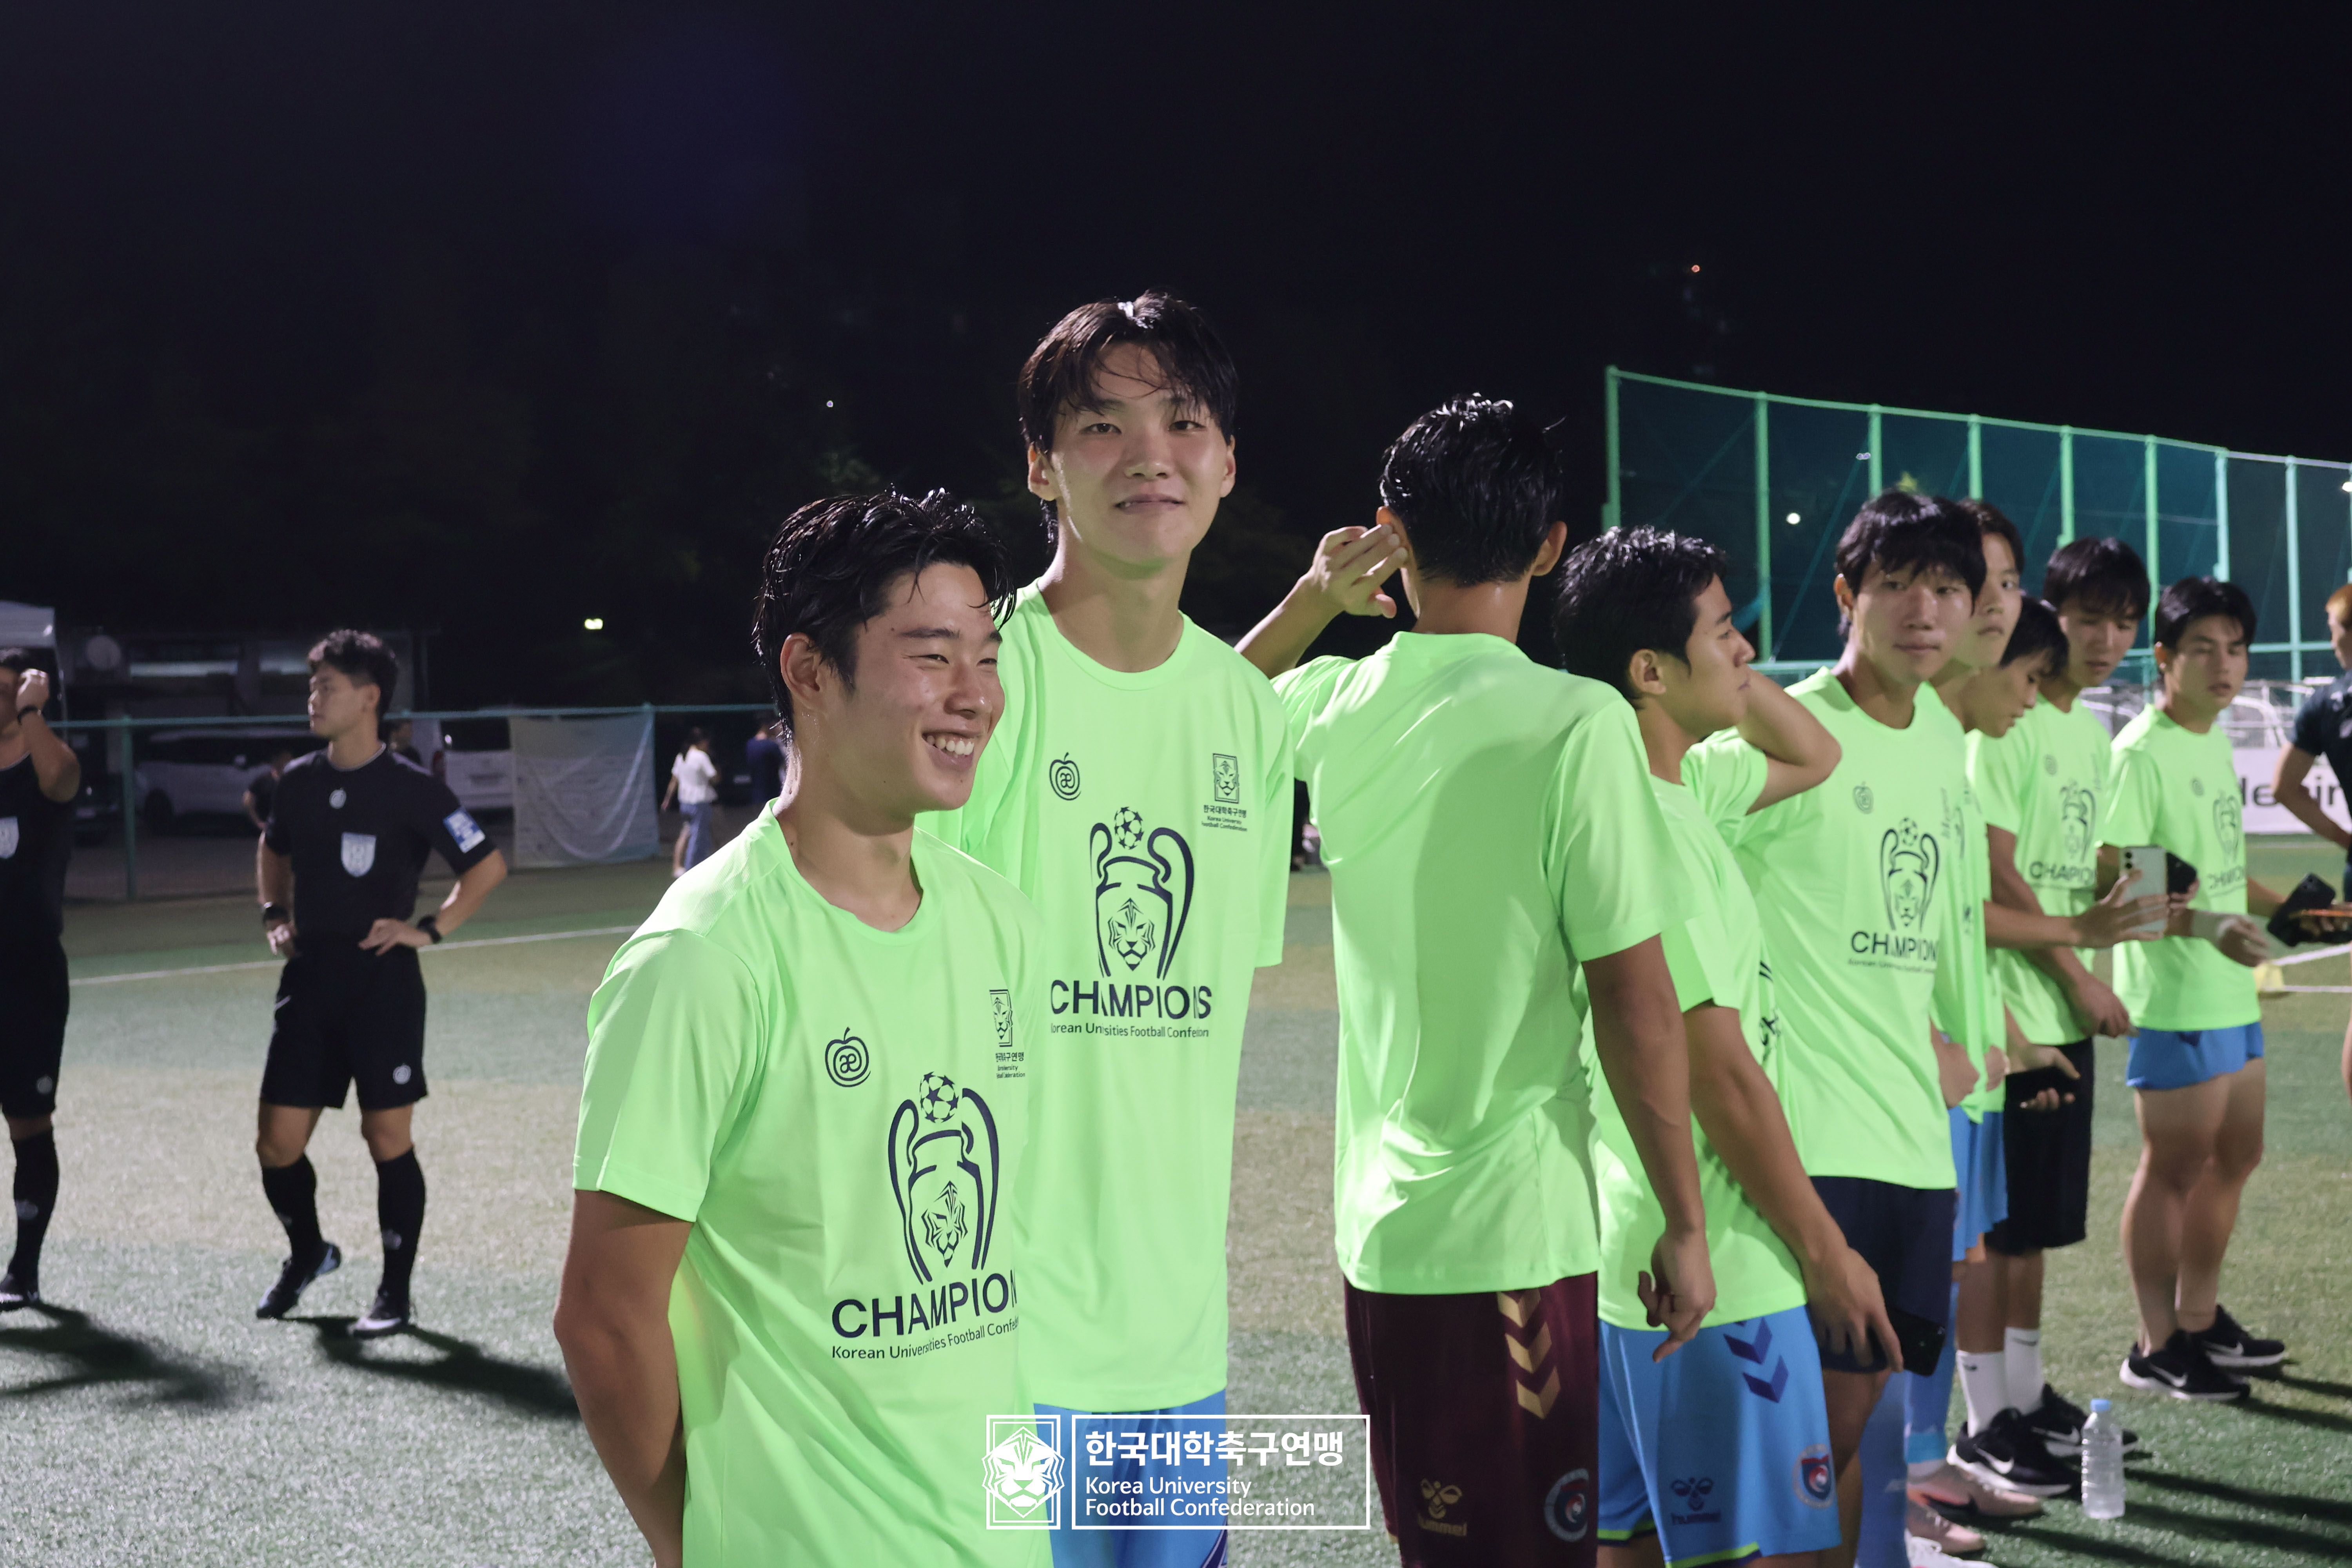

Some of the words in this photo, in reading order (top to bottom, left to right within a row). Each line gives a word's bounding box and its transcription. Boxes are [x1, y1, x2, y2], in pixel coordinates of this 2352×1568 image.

[1051, 1024, 1082, 1034] orean
[1131, 1025, 1166, 1037] Football
[832, 1345, 885, 1359] Korean
[889, 1337, 946, 1359] Universities
[947, 1325, 985, 1346] Football
